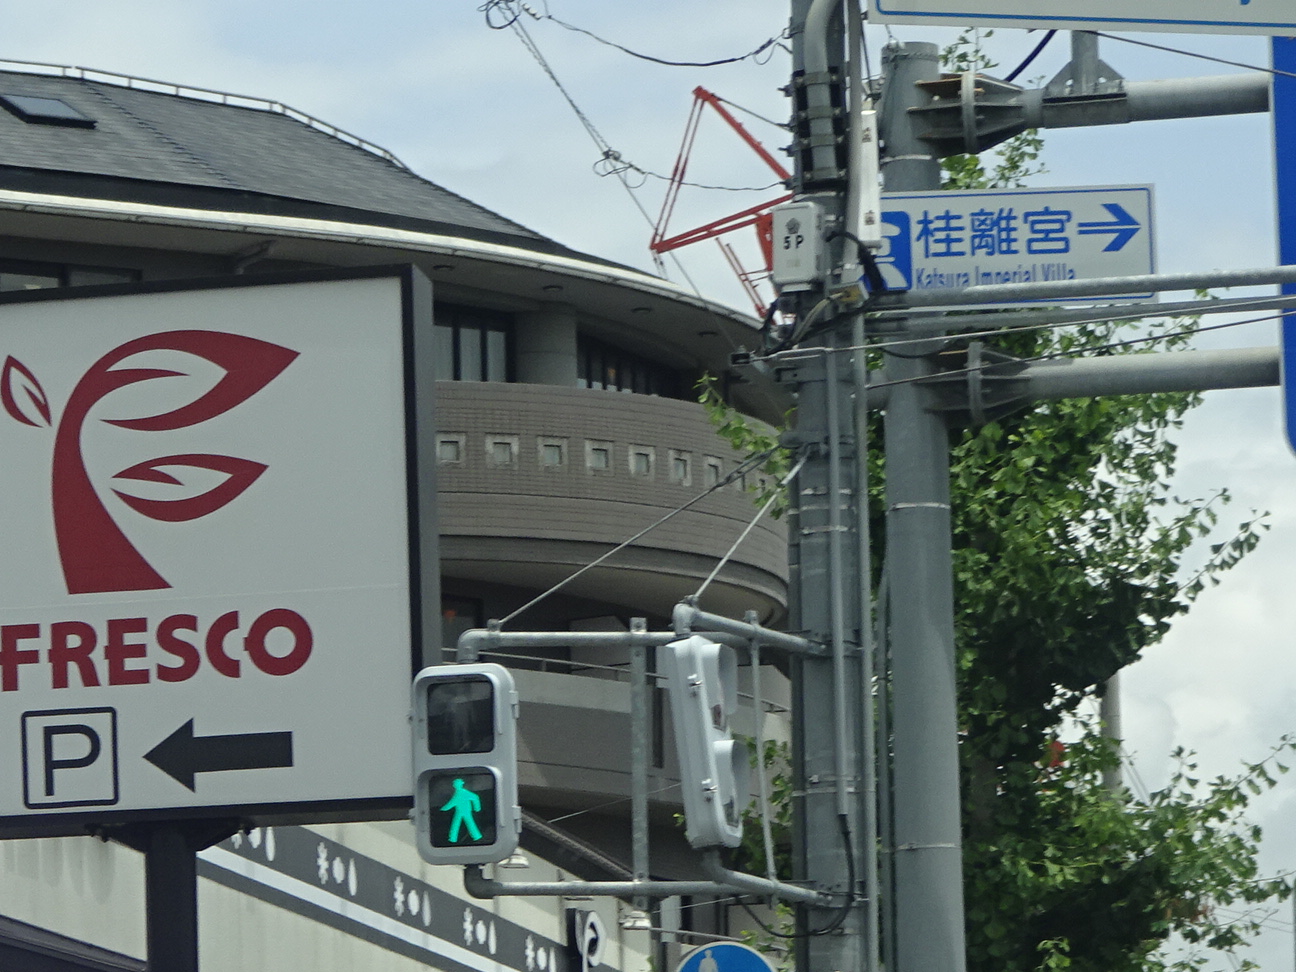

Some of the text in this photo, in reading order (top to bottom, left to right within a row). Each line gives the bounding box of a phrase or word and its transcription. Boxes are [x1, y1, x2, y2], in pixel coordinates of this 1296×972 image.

[916, 206, 1072, 258] 桂離宮
[916, 267, 970, 289] Katsura
[1042, 263, 1076, 281] Villa
[43, 723, 102, 797] P
